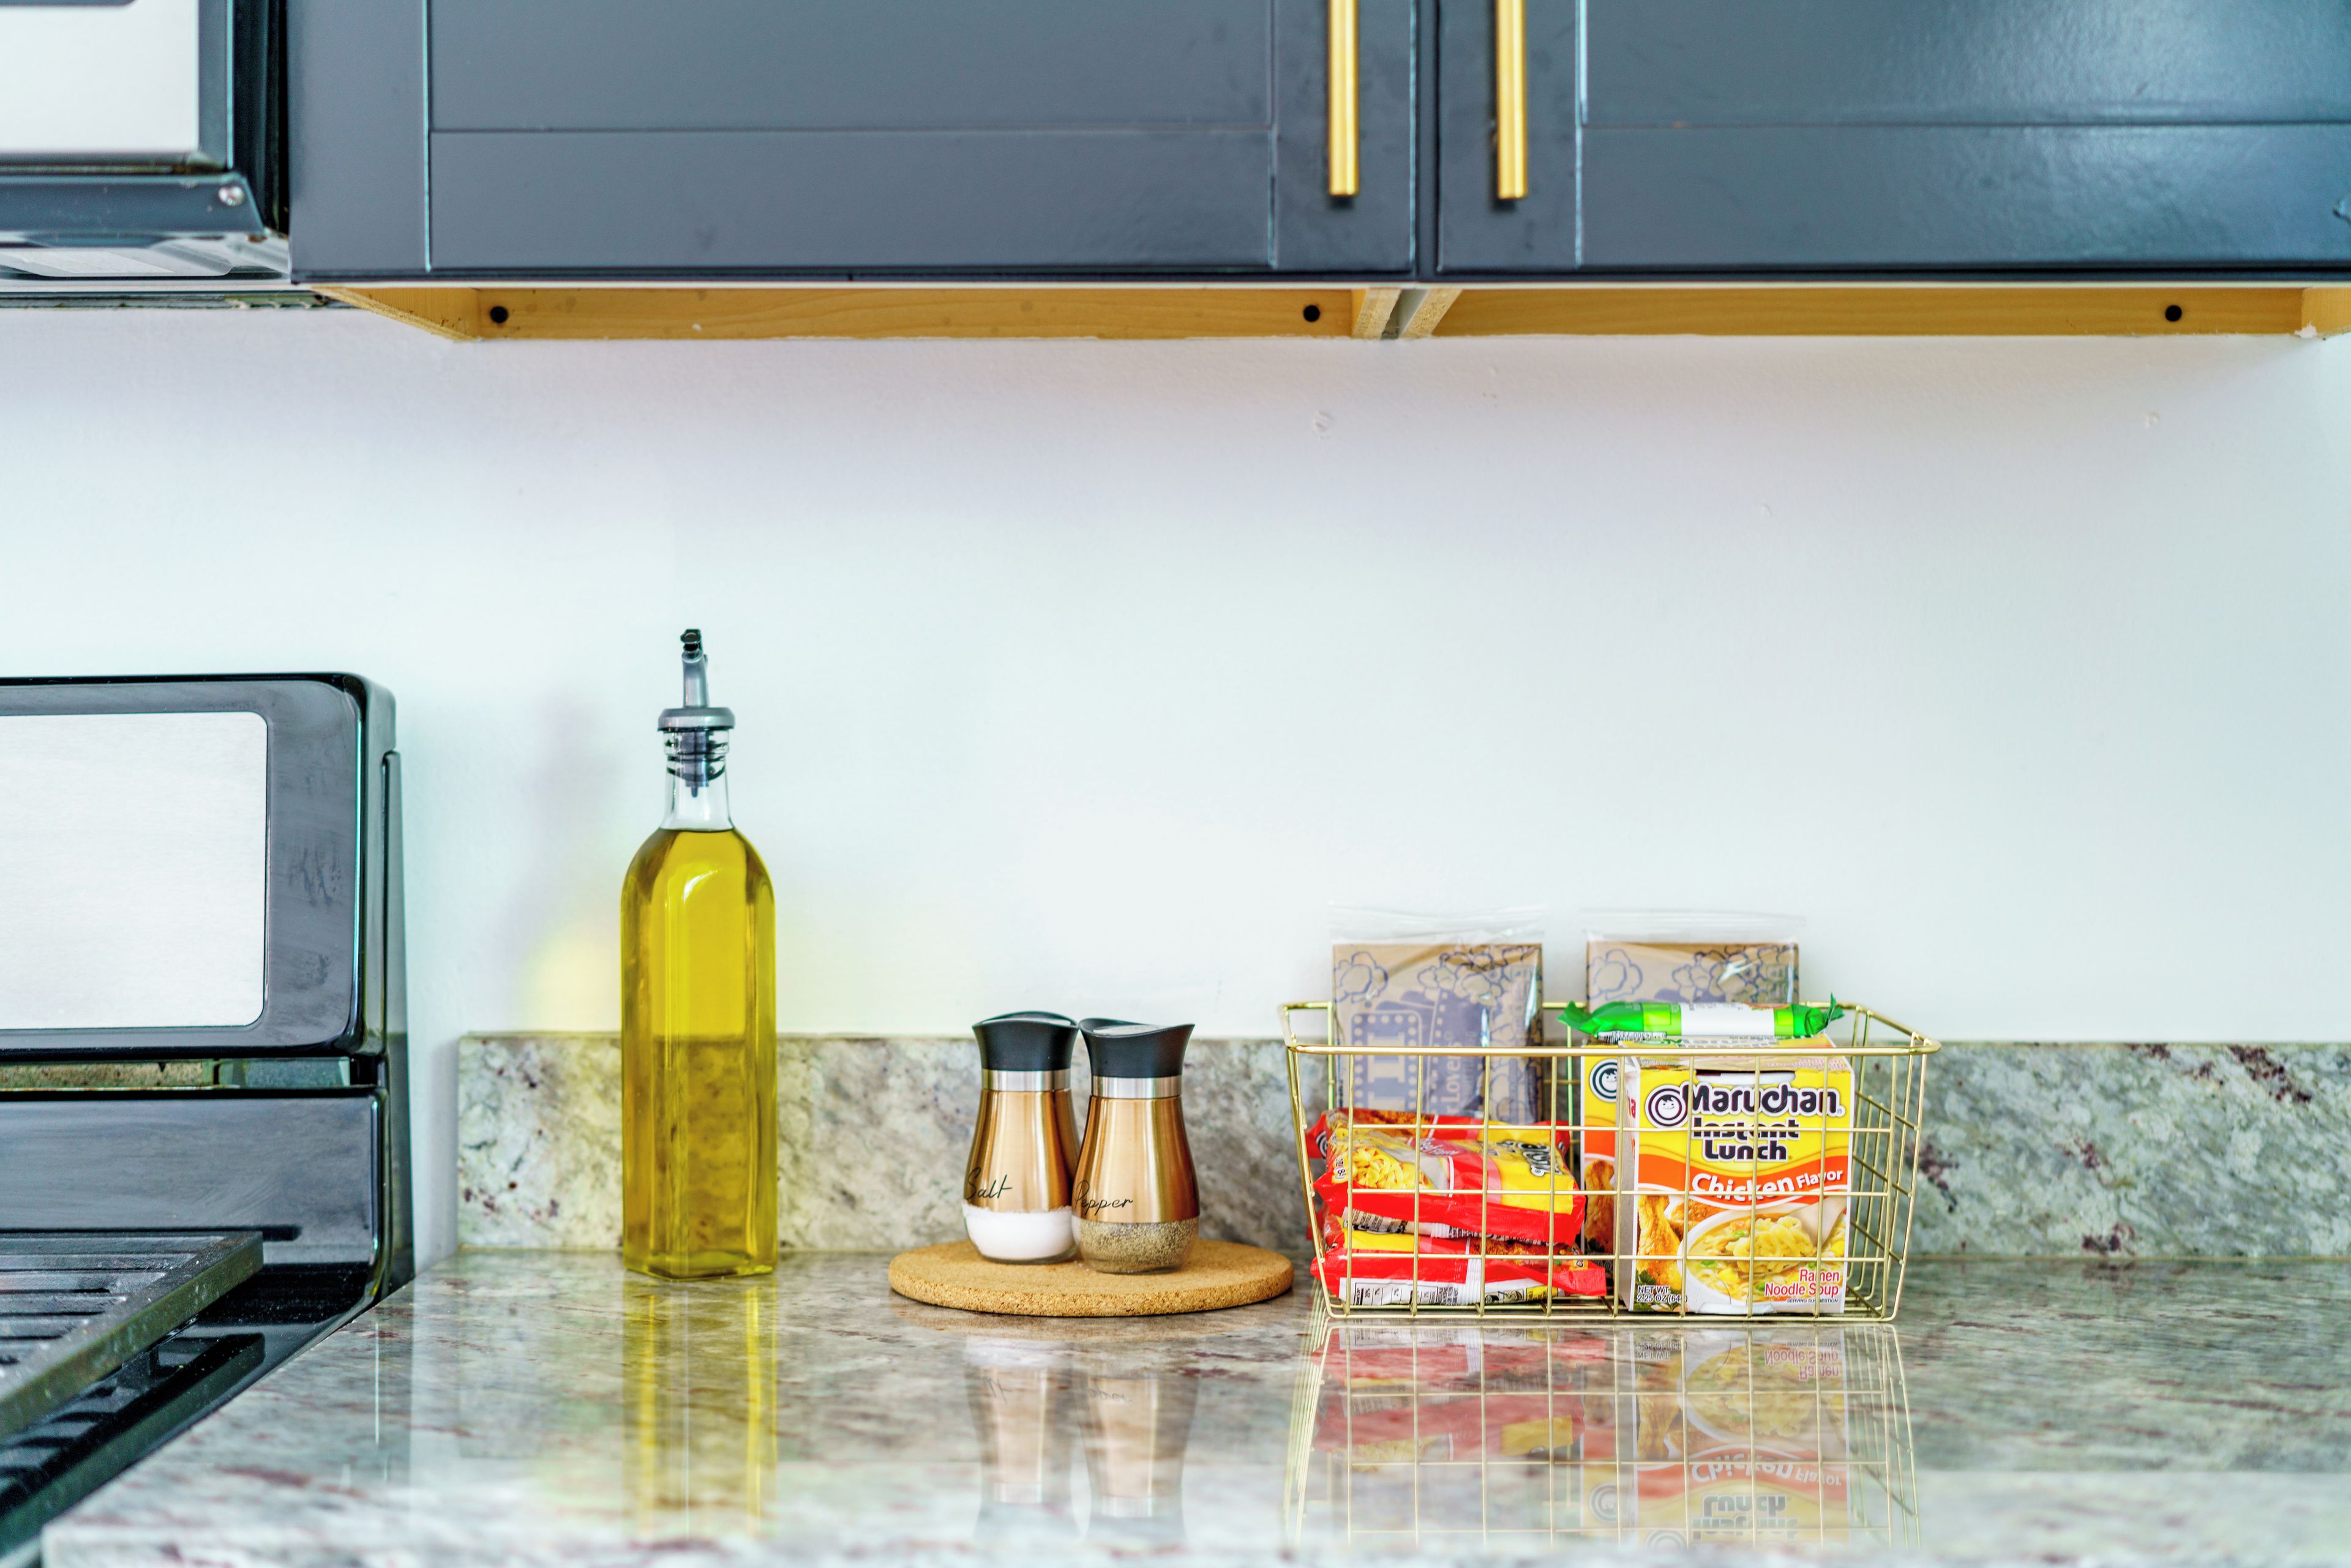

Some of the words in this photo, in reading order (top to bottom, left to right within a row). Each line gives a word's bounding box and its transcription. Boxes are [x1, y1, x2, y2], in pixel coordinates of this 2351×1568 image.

[1682, 1084, 1837, 1114] Maruchan
[1704, 1139, 1787, 1160] Lunch
[966, 1167, 1012, 1200] Salt
[1692, 1172, 1795, 1202] Chicken
[1074, 1180, 1133, 1215] Pepper
[1799, 1269, 1840, 1281] Ramen
[1668, 1294, 1688, 1304] (64)
[1765, 1283, 1805, 1296] Noodle
[1809, 1283, 1839, 1298] Soup
